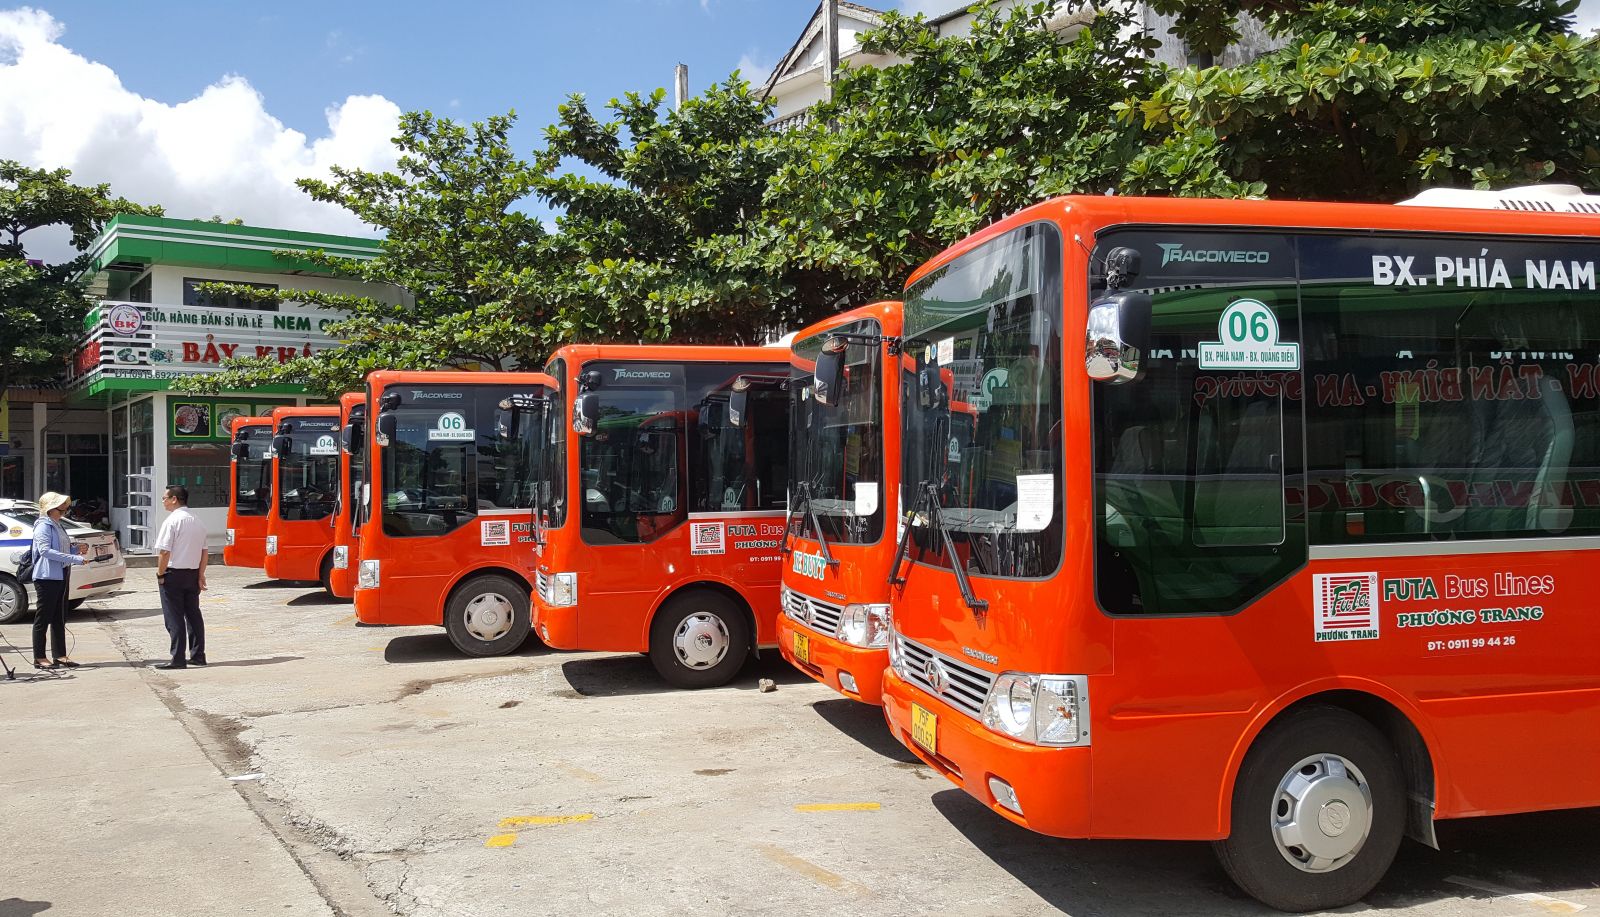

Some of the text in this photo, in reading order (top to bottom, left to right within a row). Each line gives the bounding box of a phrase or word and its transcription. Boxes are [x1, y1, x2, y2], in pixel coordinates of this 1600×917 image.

[1155, 242, 1270, 269] TRACOMECO
[1371, 247, 1596, 290] BX. PHÍA NAM
[170, 311, 198, 324] HÀNG
[201, 311, 222, 326] BÁN
[237, 315, 249, 328] VÀ
[274, 315, 311, 331] NEM
[1228, 311, 1269, 343] 06
[182, 333, 239, 363] BẢY
[1205, 351, 1215, 362] BX.
[1216, 349, 1230, 362] PHÍA
[1231, 351, 1245, 362] NAM
[1250, 351, 1260, 362] BX.
[612, 368, 671, 381] TRACOMECO
[411, 390, 463, 400] TRACOMECO
[442, 416, 461, 430] 06
[320, 438, 333, 448] 04
[728, 524, 757, 536] FUTA
[760, 523, 784, 535] Bus
[1383, 572, 1555, 602] FUTA Bus Lines
[1396, 606, 1544, 628] PHƯƠNG TRANG
[1351, 629, 1378, 639] TRANG
[1447, 639, 1470, 650] 0911
[1472, 638, 1485, 648] 99
[1487, 637, 1501, 647] 44
[1503, 636, 1516, 646] 26
